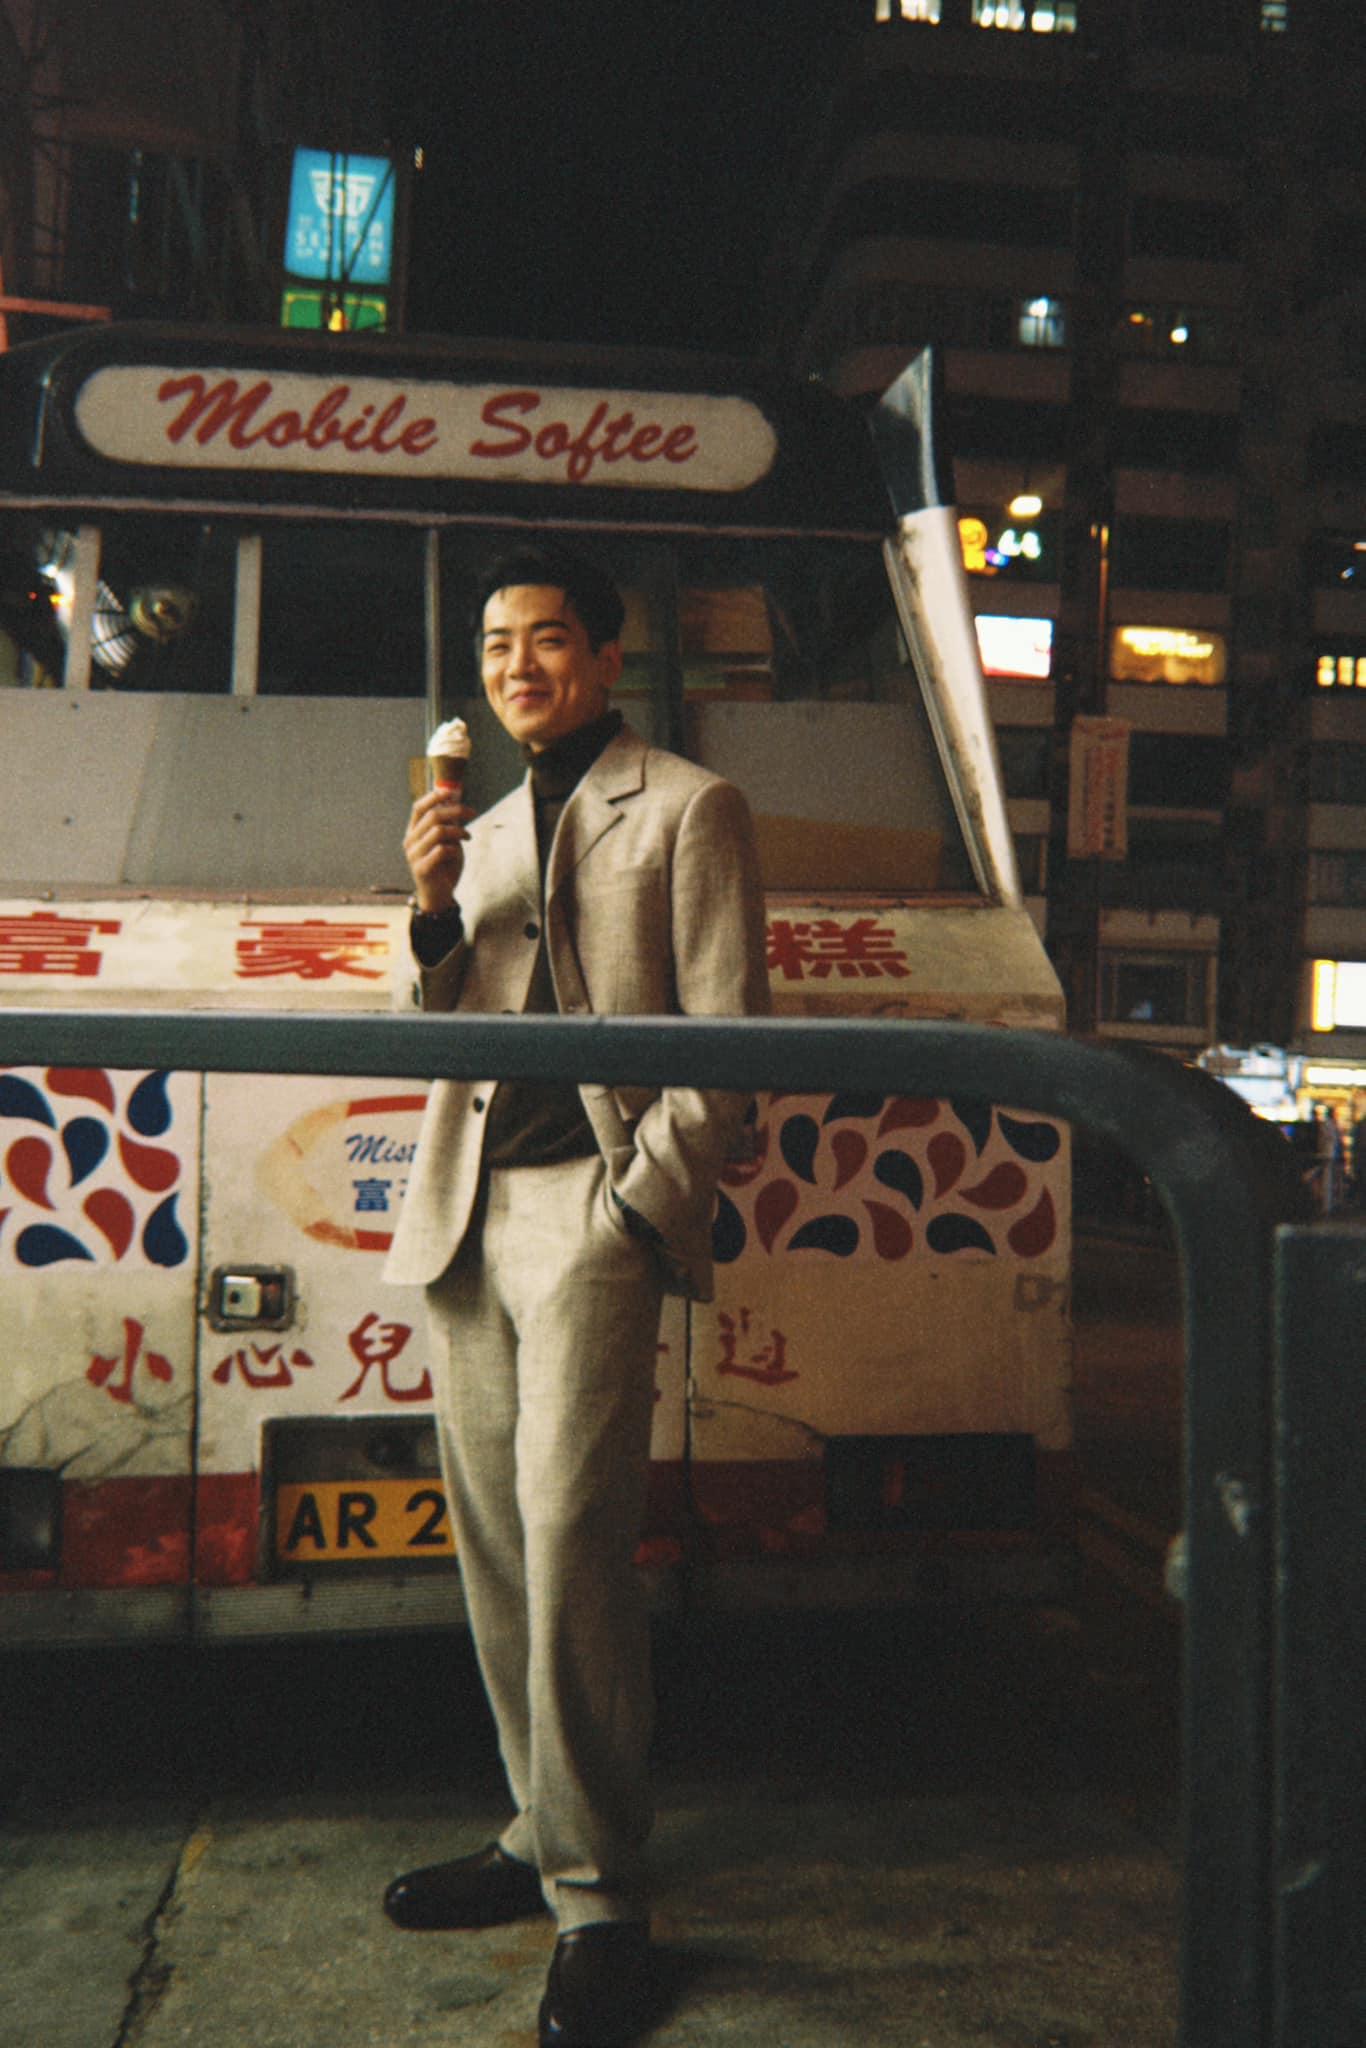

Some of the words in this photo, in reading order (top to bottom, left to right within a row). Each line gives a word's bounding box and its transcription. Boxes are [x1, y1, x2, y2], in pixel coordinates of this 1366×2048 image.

[158, 375, 439, 455] Mobile
[469, 391, 698, 482] Softee
[287, 1492, 378, 1551] AR
[405, 1489, 448, 1547] 2
